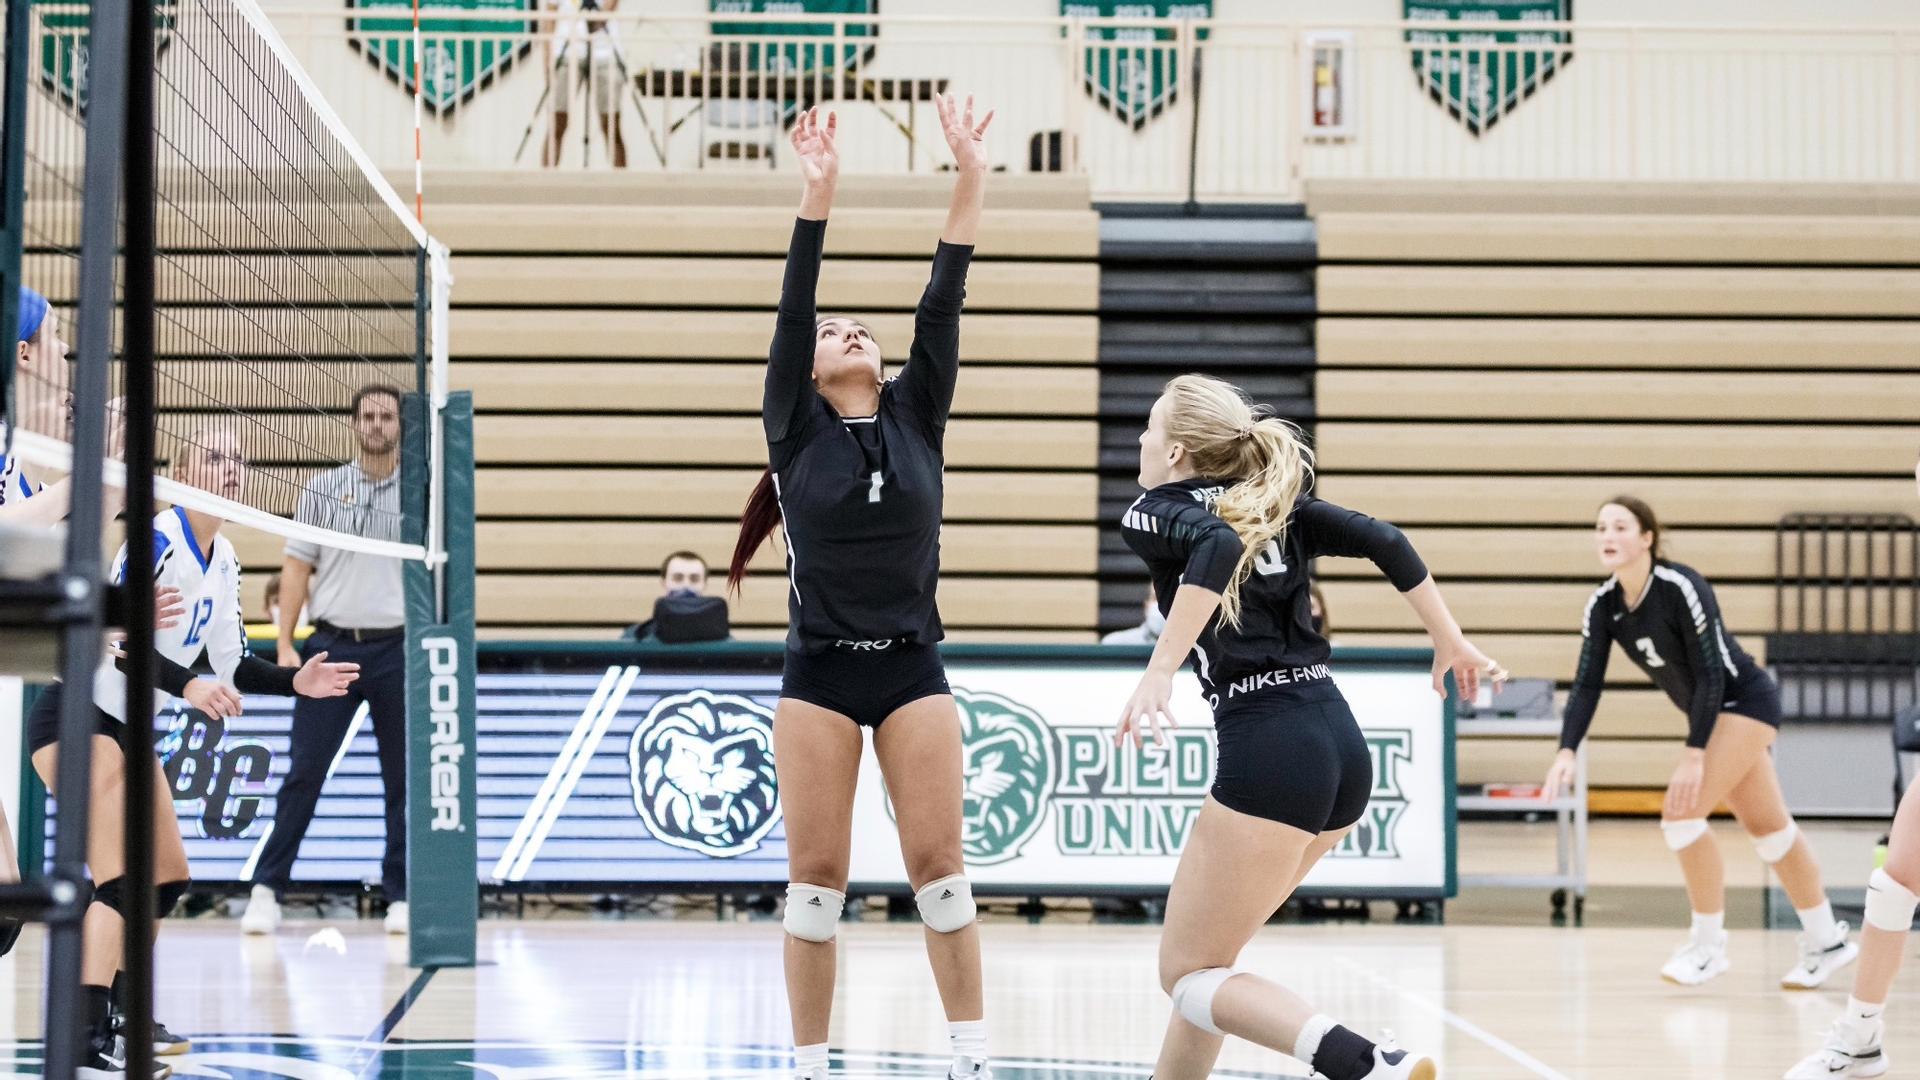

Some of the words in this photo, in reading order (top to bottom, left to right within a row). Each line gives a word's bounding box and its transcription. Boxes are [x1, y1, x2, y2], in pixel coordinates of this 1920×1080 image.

[868, 470, 884, 503] 1
[182, 597, 213, 648] 12
[835, 639, 892, 651] PRO
[1635, 636, 1666, 668] 3
[1228, 669, 1291, 698] NIKE
[1056, 728, 1411, 797] PIEDT
